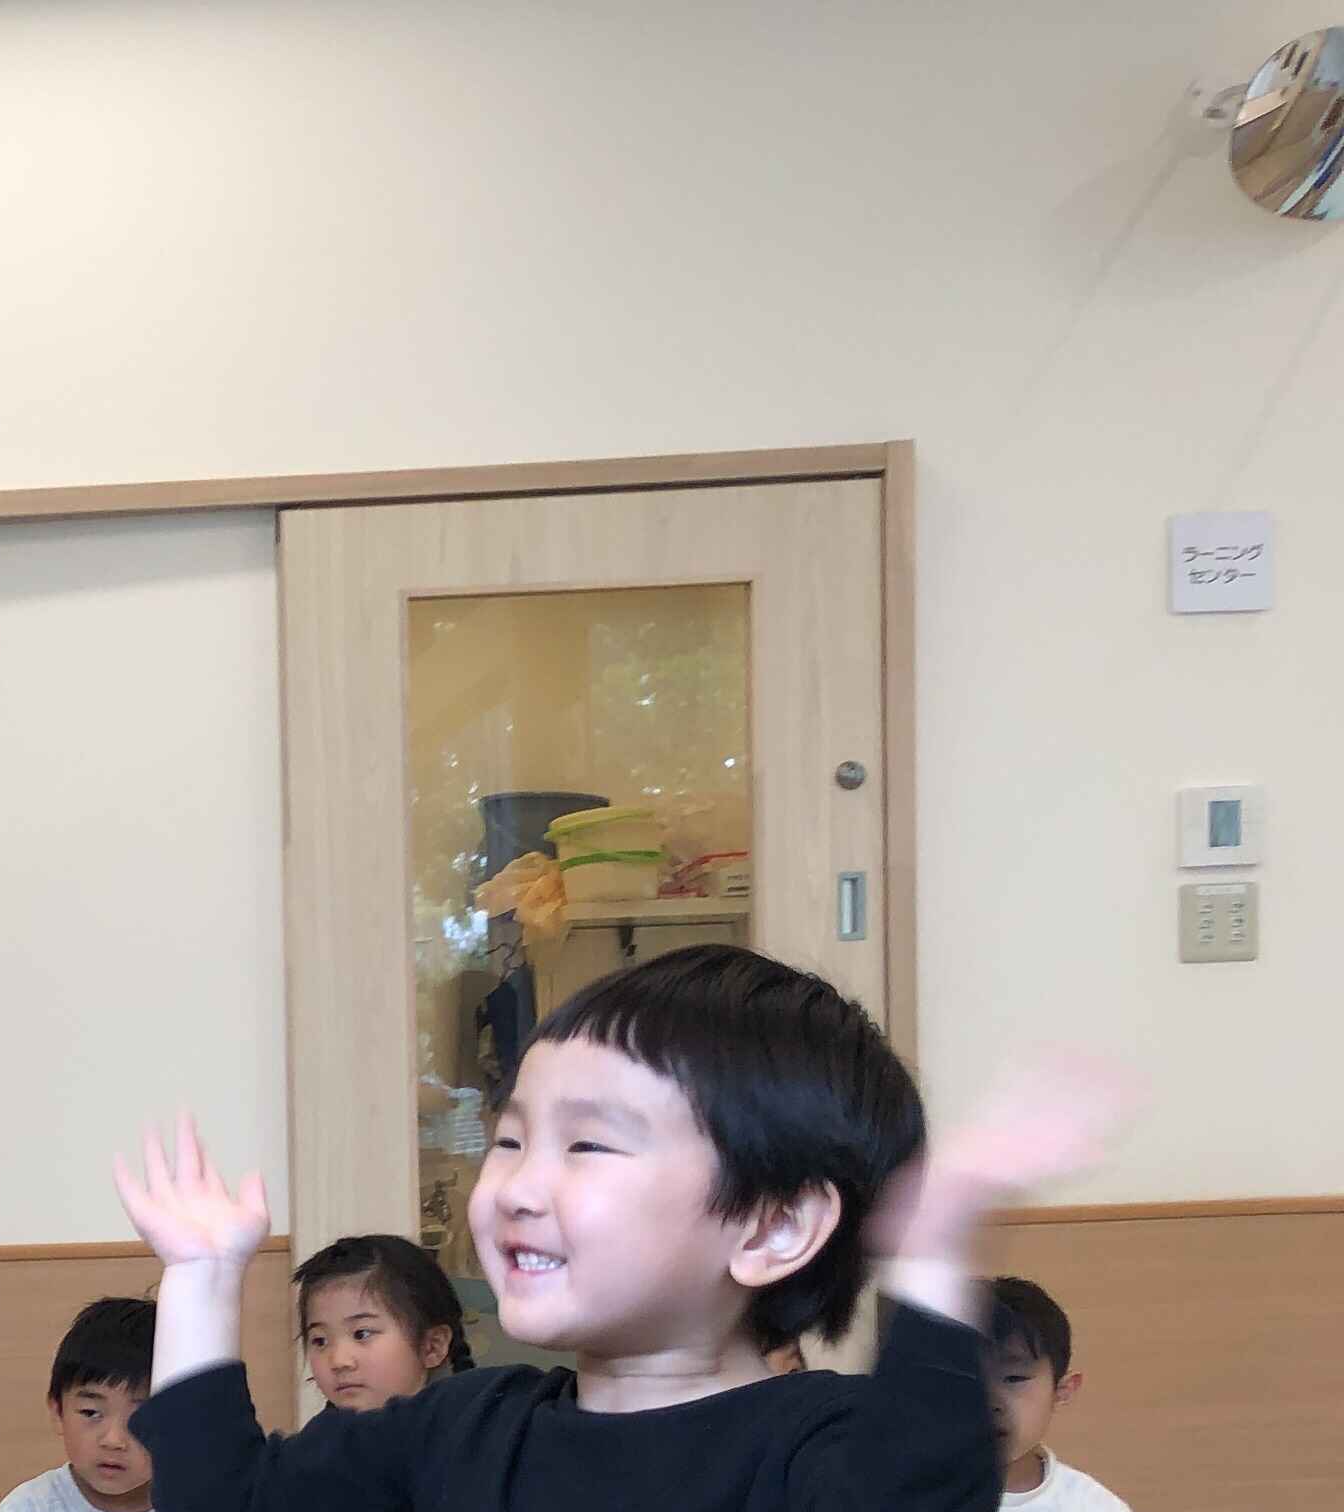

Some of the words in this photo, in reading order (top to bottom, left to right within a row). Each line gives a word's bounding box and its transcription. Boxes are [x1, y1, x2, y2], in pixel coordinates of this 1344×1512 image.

[1183, 544, 1264, 562] ラーニング
[1188, 569, 1257, 584] センター
